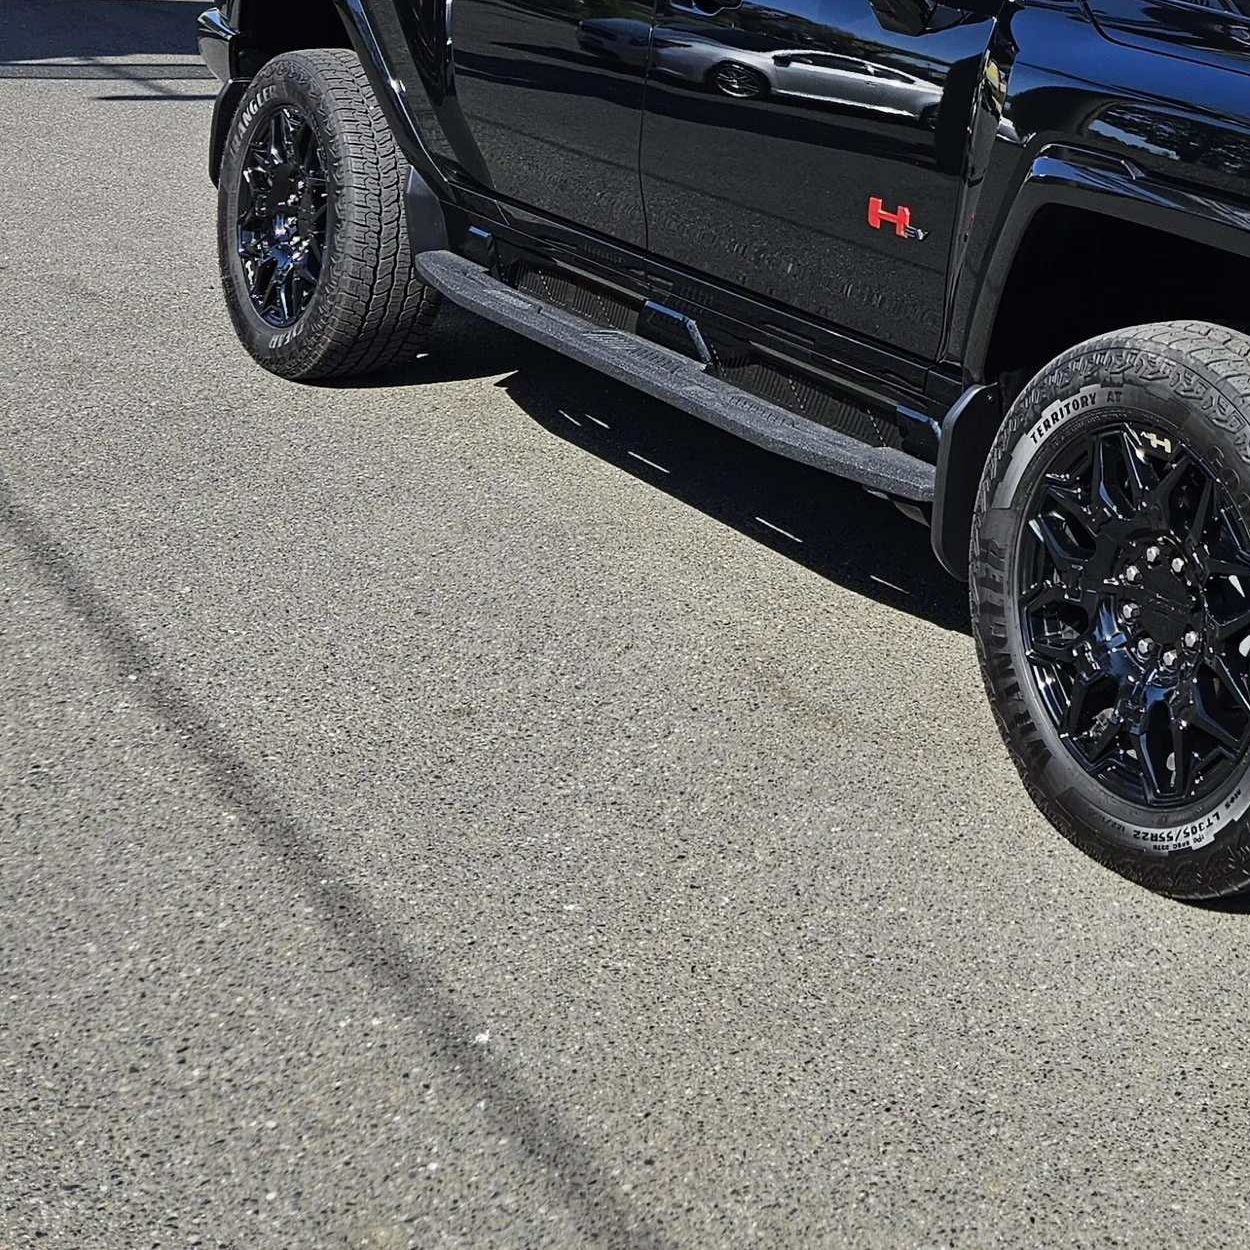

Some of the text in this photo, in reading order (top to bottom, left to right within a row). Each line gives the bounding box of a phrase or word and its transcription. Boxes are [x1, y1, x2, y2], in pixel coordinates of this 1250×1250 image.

[1030, 392, 1097, 445] TERRITORY
[1106, 391, 1123, 403] AT
[1132, 811, 1221, 843] LT305/55R22
